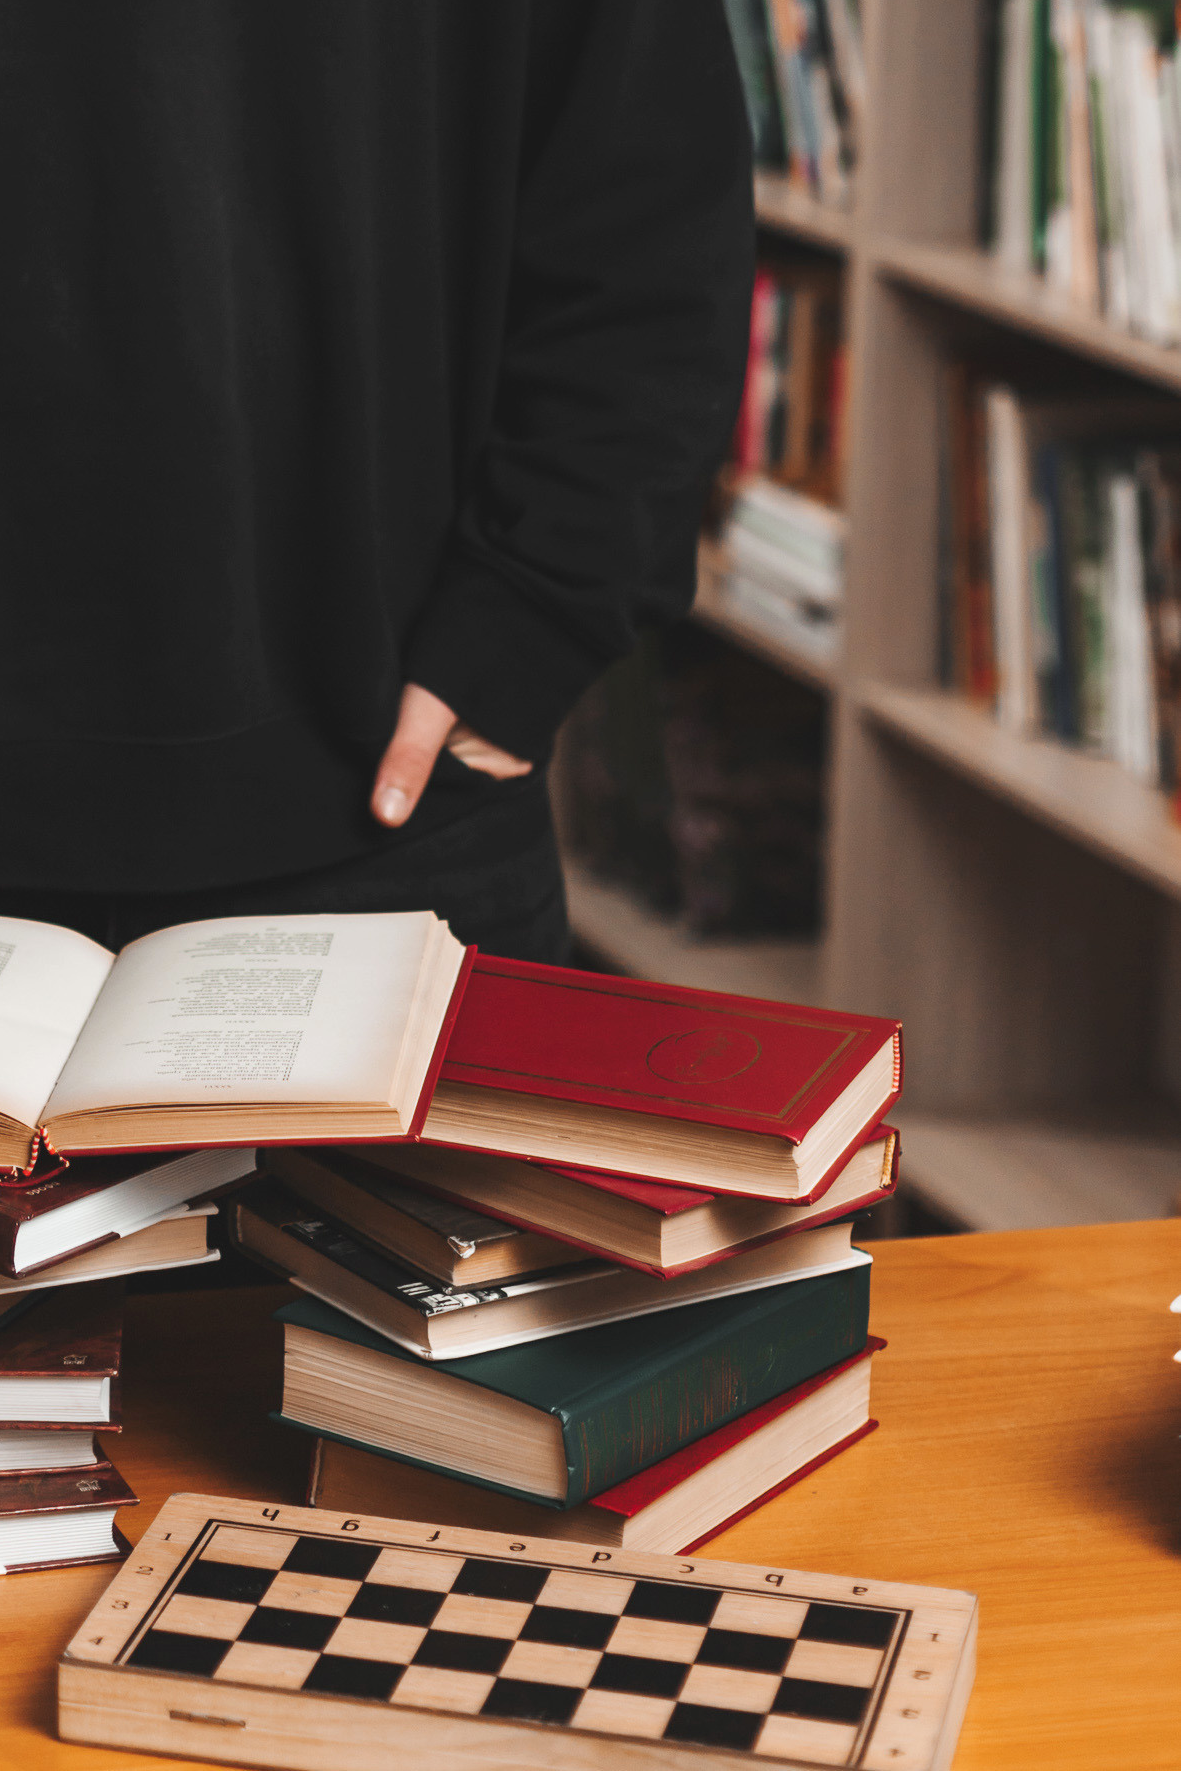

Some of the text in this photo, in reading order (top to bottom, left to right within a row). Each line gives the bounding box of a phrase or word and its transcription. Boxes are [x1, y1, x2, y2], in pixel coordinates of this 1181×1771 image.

[163, 1532, 173, 1541] 1
[261, 1507, 869, 1596] a b c d e f g h
[135, 1564, 155, 1576] 2
[111, 1599, 131, 1610] 3
[88, 1635, 104, 1646] 4
